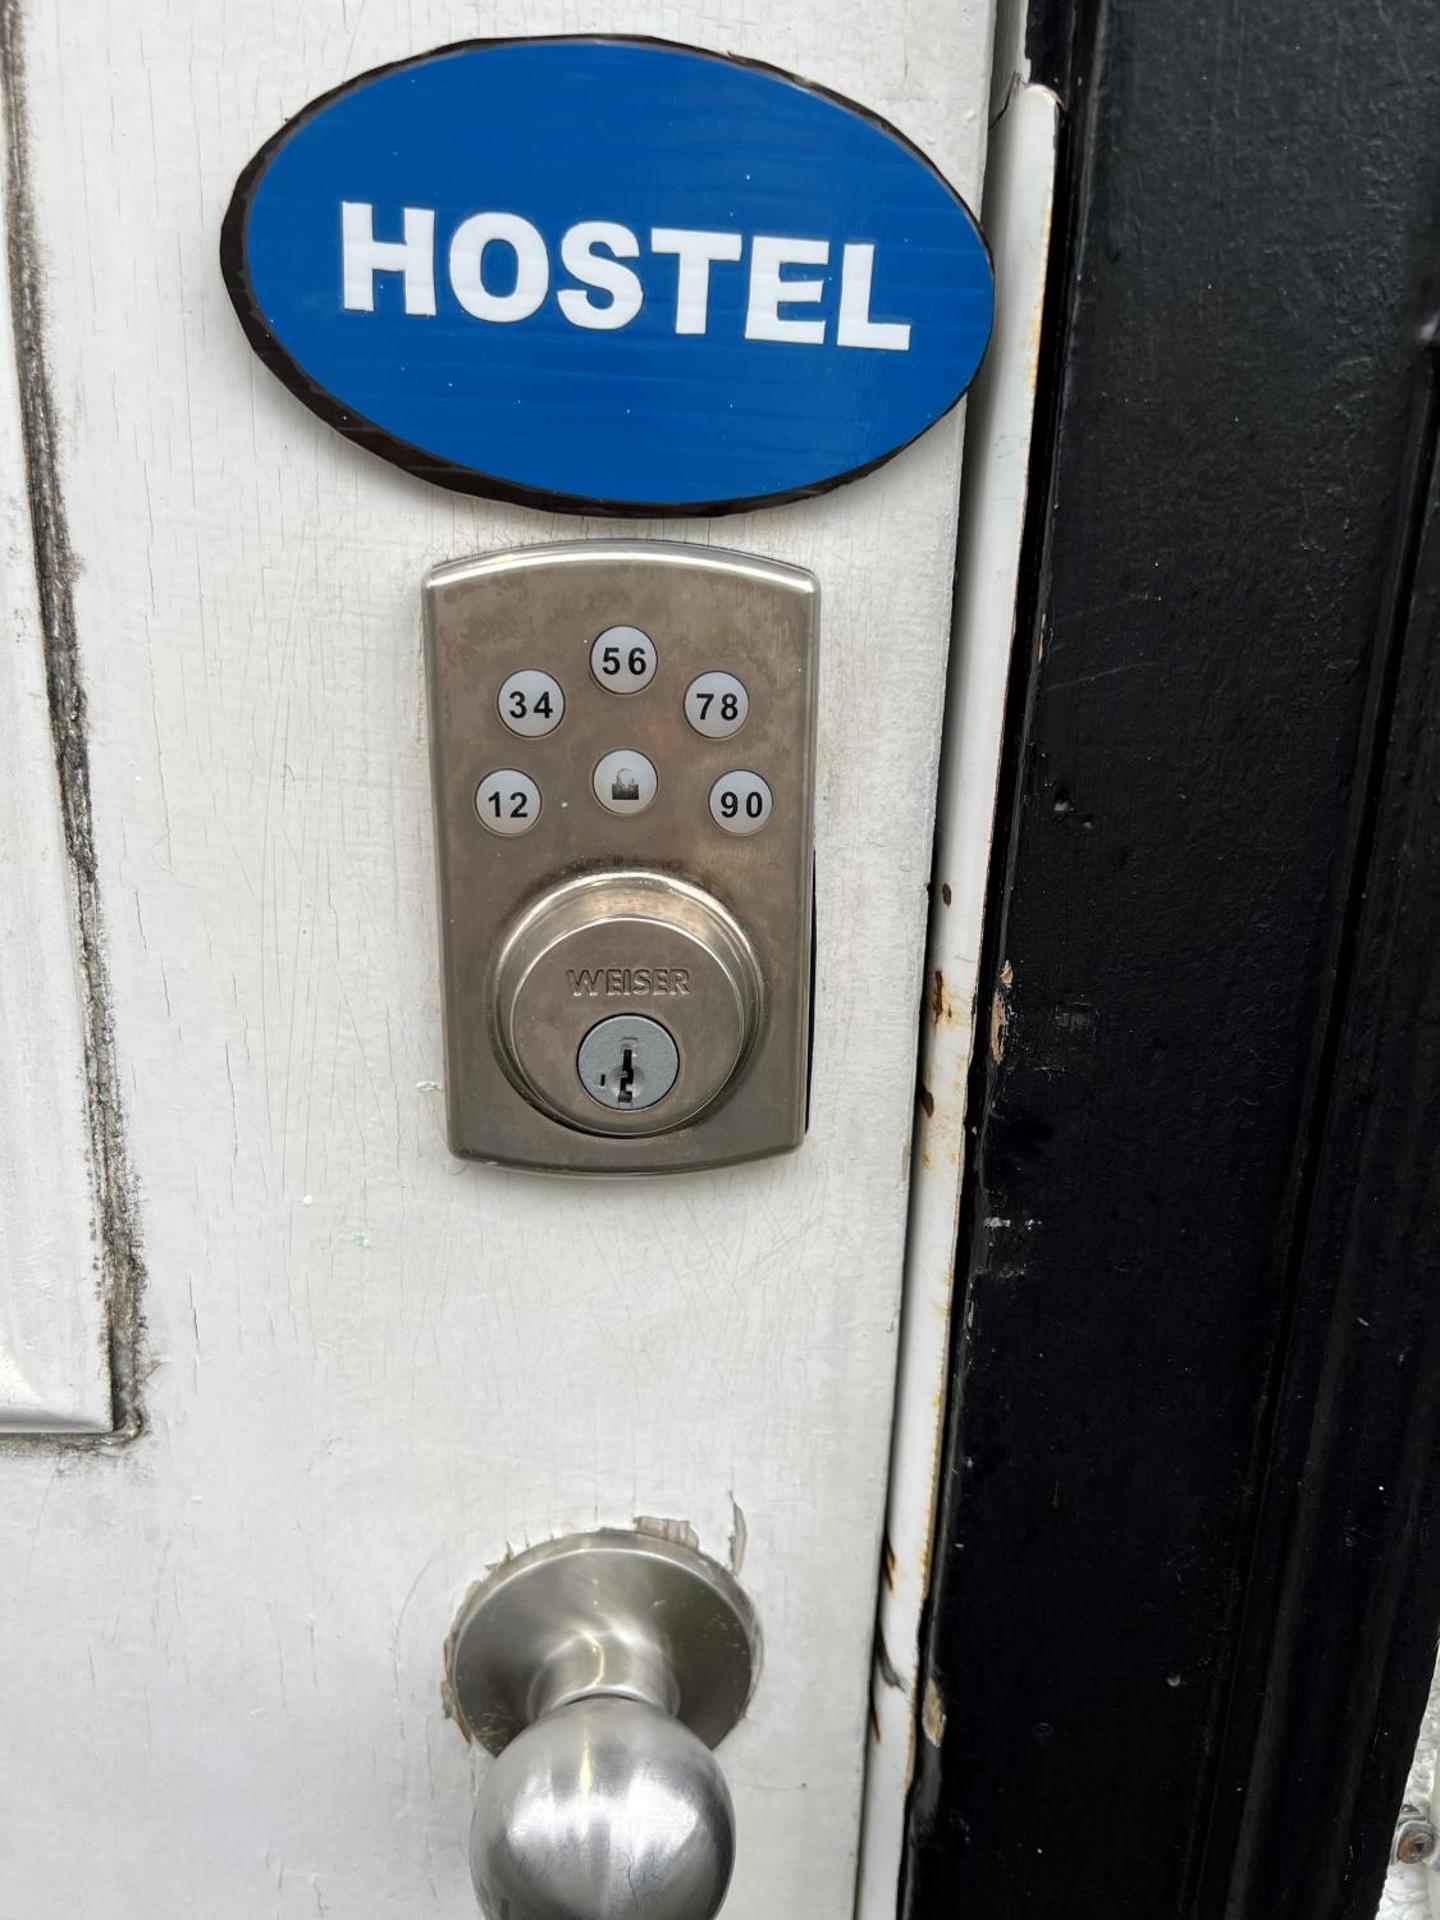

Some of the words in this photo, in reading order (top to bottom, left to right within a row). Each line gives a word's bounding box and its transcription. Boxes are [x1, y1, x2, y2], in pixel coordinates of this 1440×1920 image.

[342, 201, 911, 351] HOSTEL
[602, 647, 647, 675] 56
[509, 691, 553, 719] 34
[696, 693, 738, 720] 78
[488, 791, 528, 818] 12
[720, 791, 763, 818] 90
[567, 968, 692, 996] WEISER
